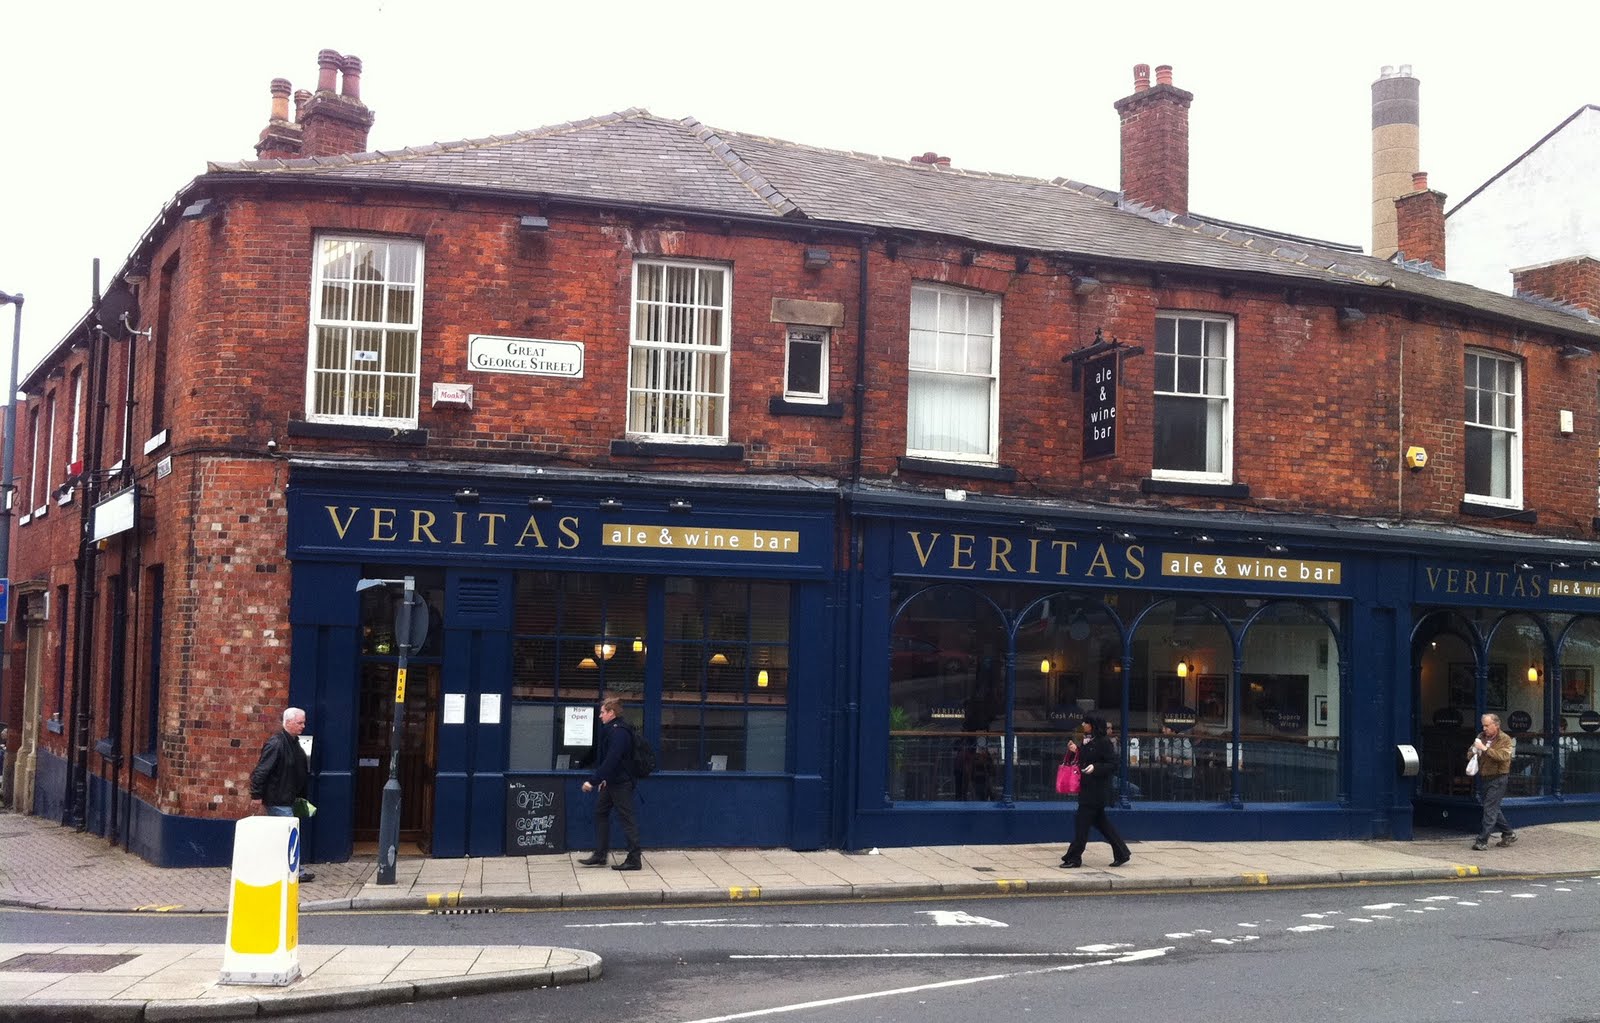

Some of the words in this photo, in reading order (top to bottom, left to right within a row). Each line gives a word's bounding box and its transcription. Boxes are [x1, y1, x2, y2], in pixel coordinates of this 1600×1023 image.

[507, 342, 547, 357] GREAT
[477, 353, 528, 369] GEORGE
[529, 357, 575, 372] STREET
[1096, 367, 1112, 384] ale
[1099, 386, 1107, 401] &
[1090, 406, 1116, 423] wine
[1093, 425, 1112, 441] bar
[324, 505, 580, 549] VERITAS
[611, 526, 647, 544] ale
[658, 528, 673, 545] &
[684, 530, 740, 548] wine
[753, 532, 792, 550] bar
[907, 531, 1146, 580] VERITAS
[1170, 556, 1204, 574] ale
[1214, 557, 1227, 576] &
[1237, 560, 1288, 578] wine
[1299, 562, 1335, 581] bar
[1426, 567, 1543, 598] VERITAS
[1552, 581, 1569, 594] ale
[1573, 582, 1581, 594] &
[516, 790, 555, 809] OPEN
